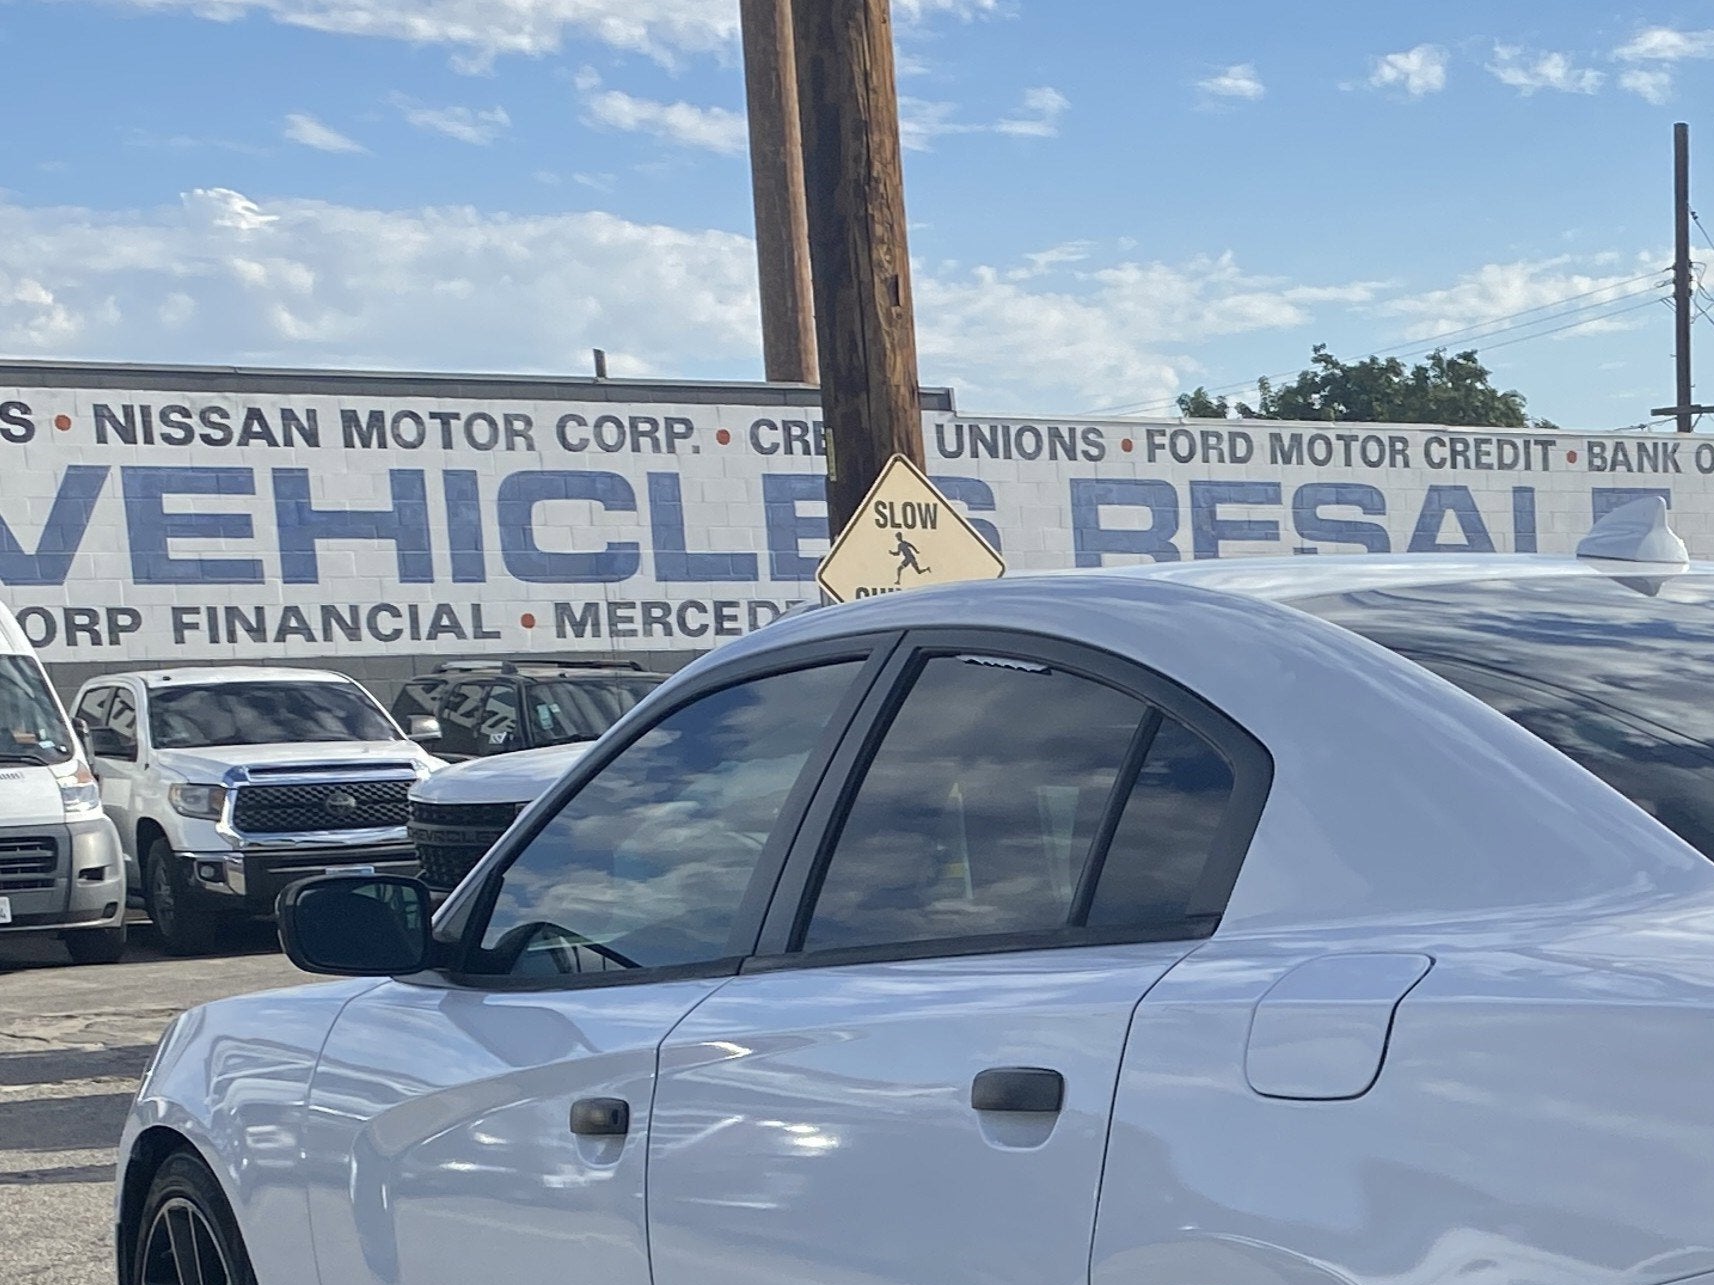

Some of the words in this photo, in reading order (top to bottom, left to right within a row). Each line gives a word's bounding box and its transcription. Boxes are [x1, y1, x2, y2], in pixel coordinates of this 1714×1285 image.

[93, 404, 320, 447] NISSAN
[343, 409, 534, 452] MOTOR
[556, 413, 699, 454] CORP.
[749, 418, 827, 456] CRE
[936, 423, 1105, 462] UNIONS
[1147, 428, 1253, 465] FORD
[1270, 431, 1409, 468] MOTOR
[1424, 436, 1556, 472] CREDIT
[1587, 440, 1681, 474] BANK
[874, 500, 938, 530] SLOW
[15, 606, 142, 648] ORP
[172, 602, 501, 645] FINANCIAL
[555, 600, 806, 639] MERCED
